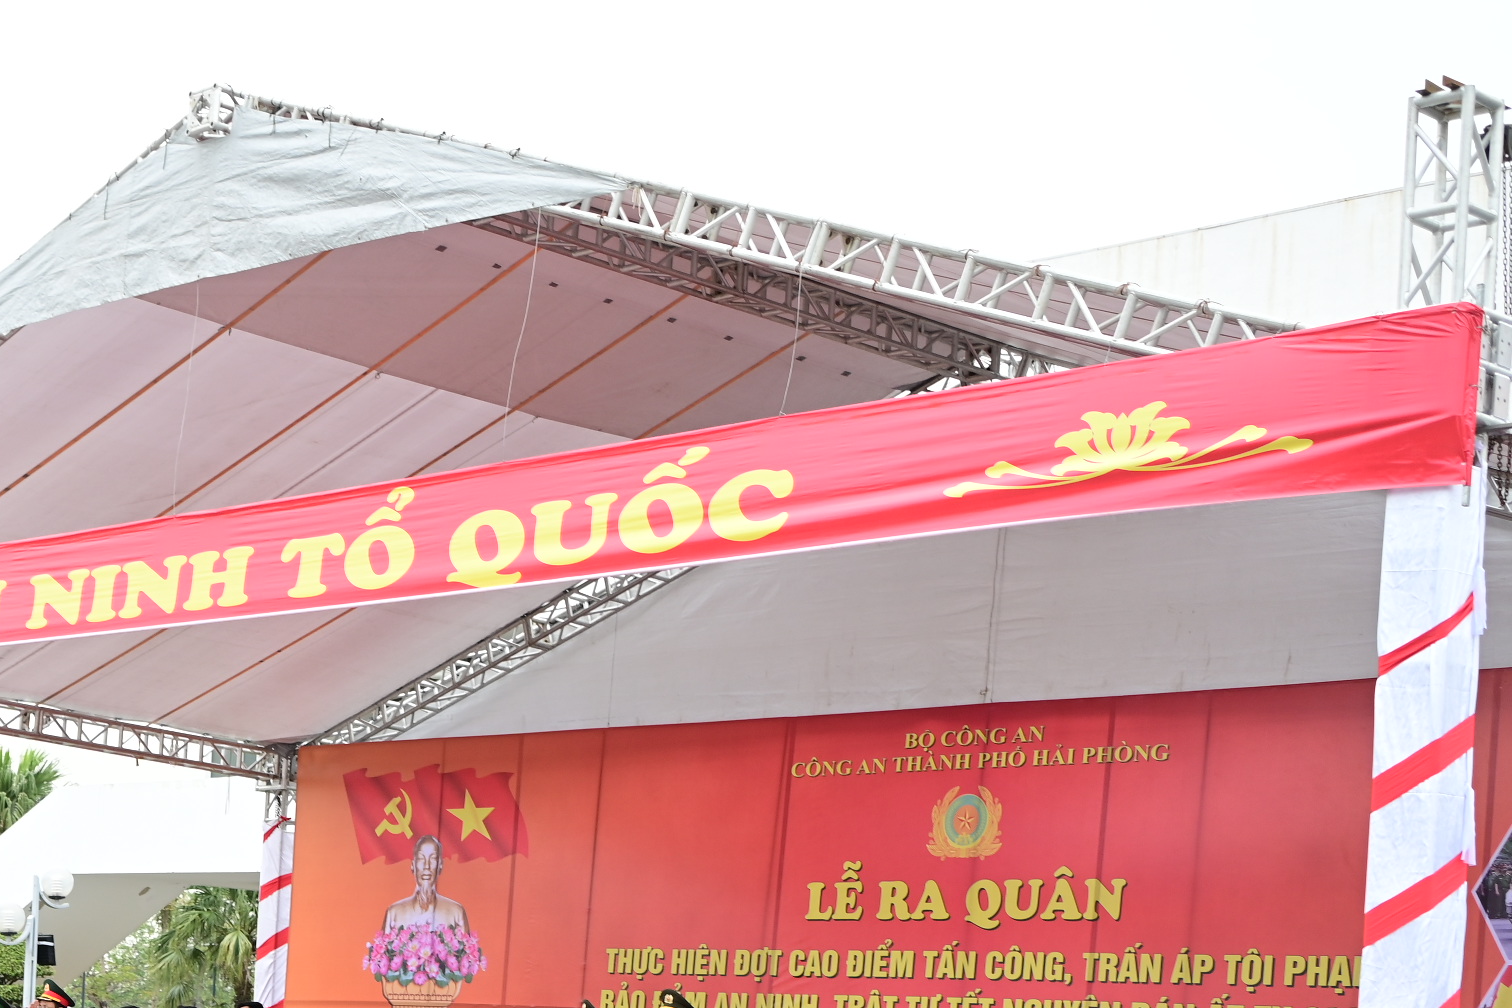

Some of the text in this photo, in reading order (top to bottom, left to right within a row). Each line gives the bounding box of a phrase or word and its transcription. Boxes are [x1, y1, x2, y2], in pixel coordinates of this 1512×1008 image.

[25, 546, 256, 630] NINH
[280, 486, 416, 598] TỔ
[445, 446, 795, 590] QUỐC
[791, 740, 1170, 778] CÔNG AN THÀNH PHỐ HẢI PHÒNG
[904, 724, 1045, 752] BỘ CÔNG AN
[805, 860, 1128, 931] LỄ RA QUÂN
[606, 946, 665, 981] THỰC
[670, 944, 729, 982] HIỆN
[734, 946, 784, 983] ĐỢT
[789, 950, 840, 980] CAO
[846, 938, 916, 979] ĐIỂM
[923, 940, 978, 980] TẤN
[985, 945, 1074, 985] CÔNG,
[1083, 942, 1164, 984] TRẤN
[1171, 947, 1216, 985] ÁP
[1224, 948, 1276, 993] TỘI
